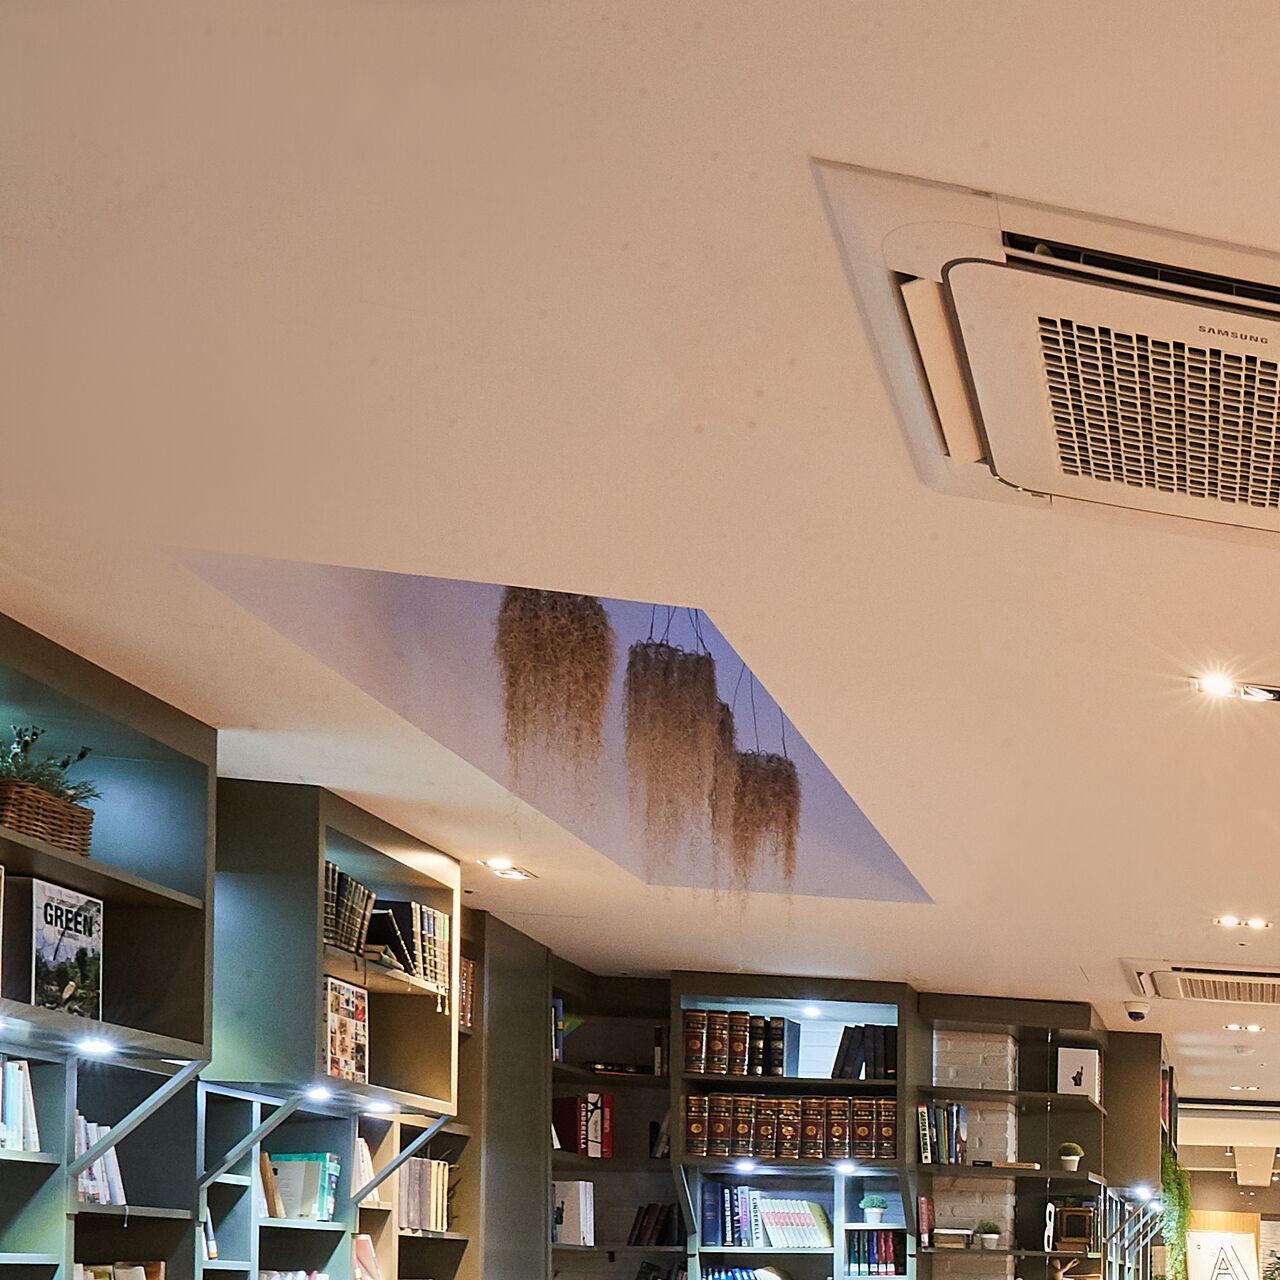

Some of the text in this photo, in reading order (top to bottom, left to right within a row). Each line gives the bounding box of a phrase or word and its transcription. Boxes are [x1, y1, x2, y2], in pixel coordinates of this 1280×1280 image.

[1198, 325, 1269, 344] SAMSUNG
[43, 902, 93, 938] GREEN
[751, 1197, 760, 1241] CINDERELLA
